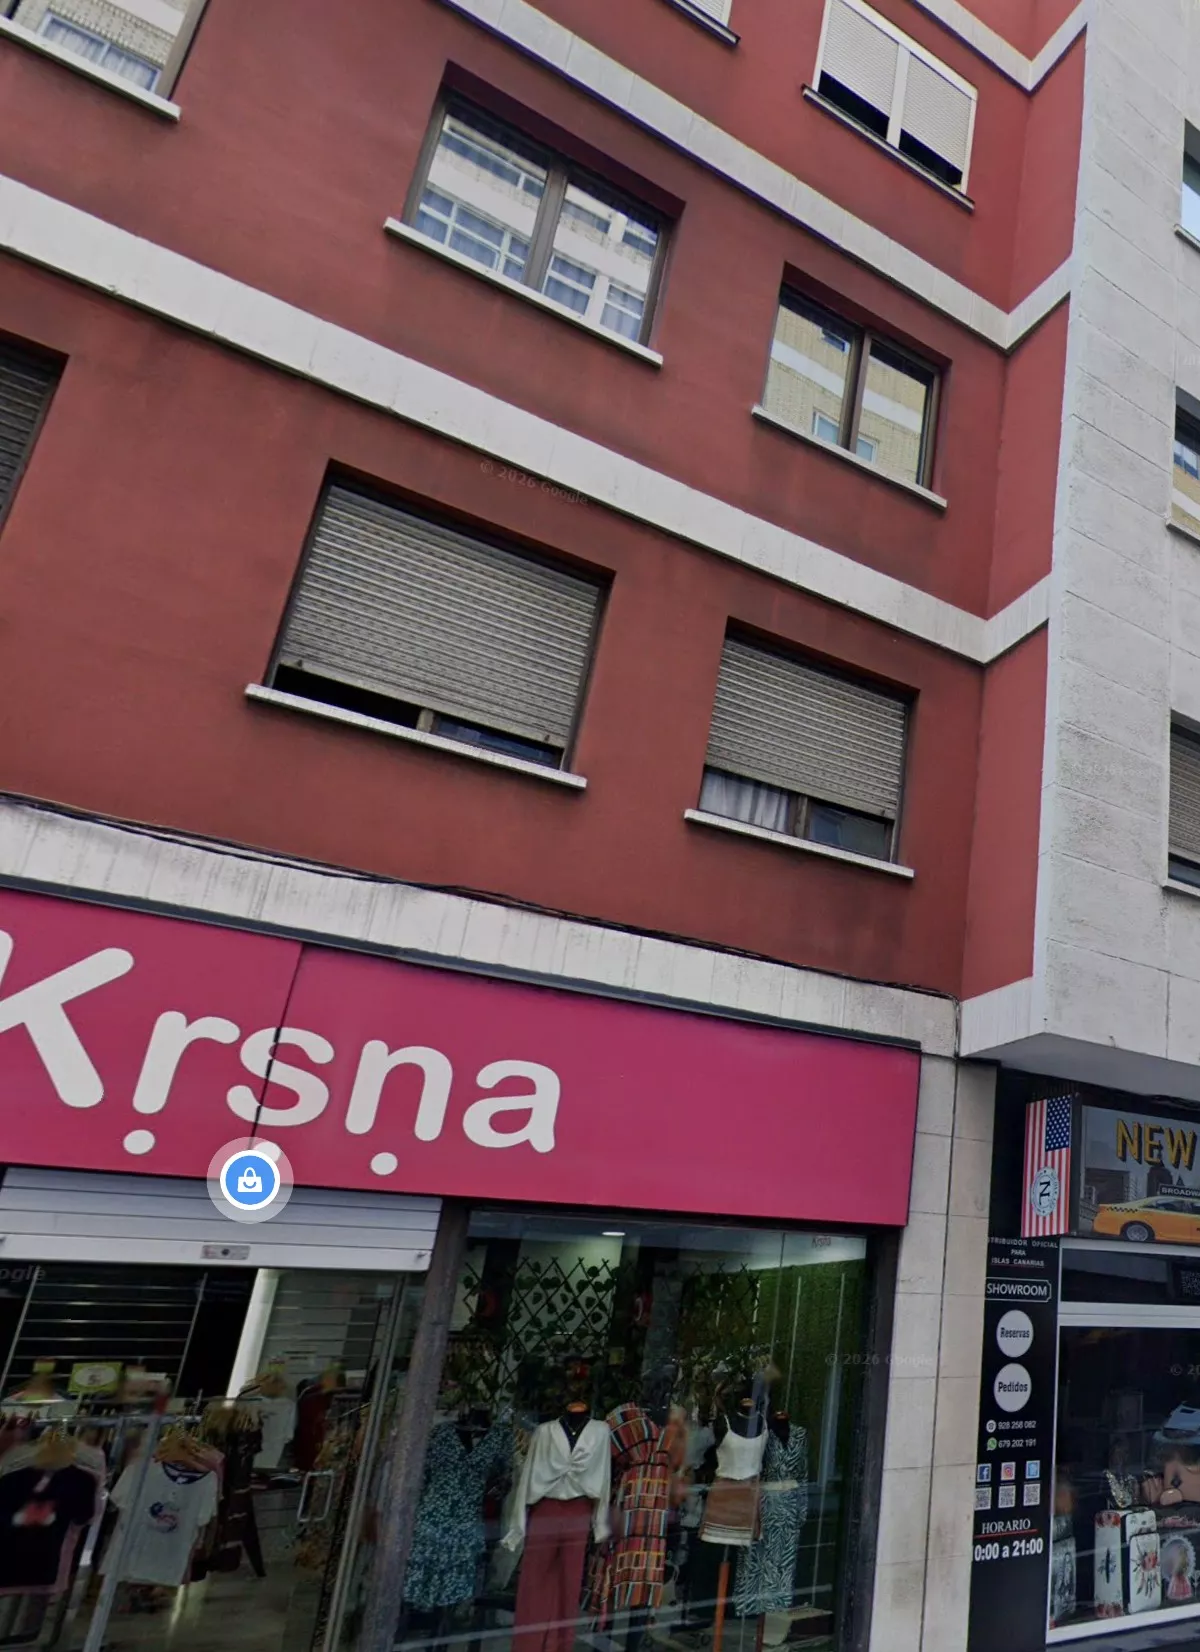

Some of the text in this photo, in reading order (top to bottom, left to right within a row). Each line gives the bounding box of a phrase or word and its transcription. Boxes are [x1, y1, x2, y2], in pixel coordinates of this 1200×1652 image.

[1116, 1118, 1196, 1171] NEW
[988, 1236, 1058, 1248] TRIBUIDOR OFICIAL
[1010, 1248, 1026, 1256] PARA
[991, 1257, 1045, 1267] ISLAS CANARIAS
[986, 1282, 1047, 1297] SHOWROOM
[1000, 1326, 1030, 1339] Reservas
[998, 1381, 1028, 1393] Pedidos
[998, 1421, 1011, 1430] 928
[1011, 1438, 1024, 1448] 202
[1025, 1438, 1037, 1448] 191
[981, 1518, 1031, 1535] HORARIO
[1002, 1545, 1010, 1558] a
[1012, 1537, 1044, 1557] 21:00
